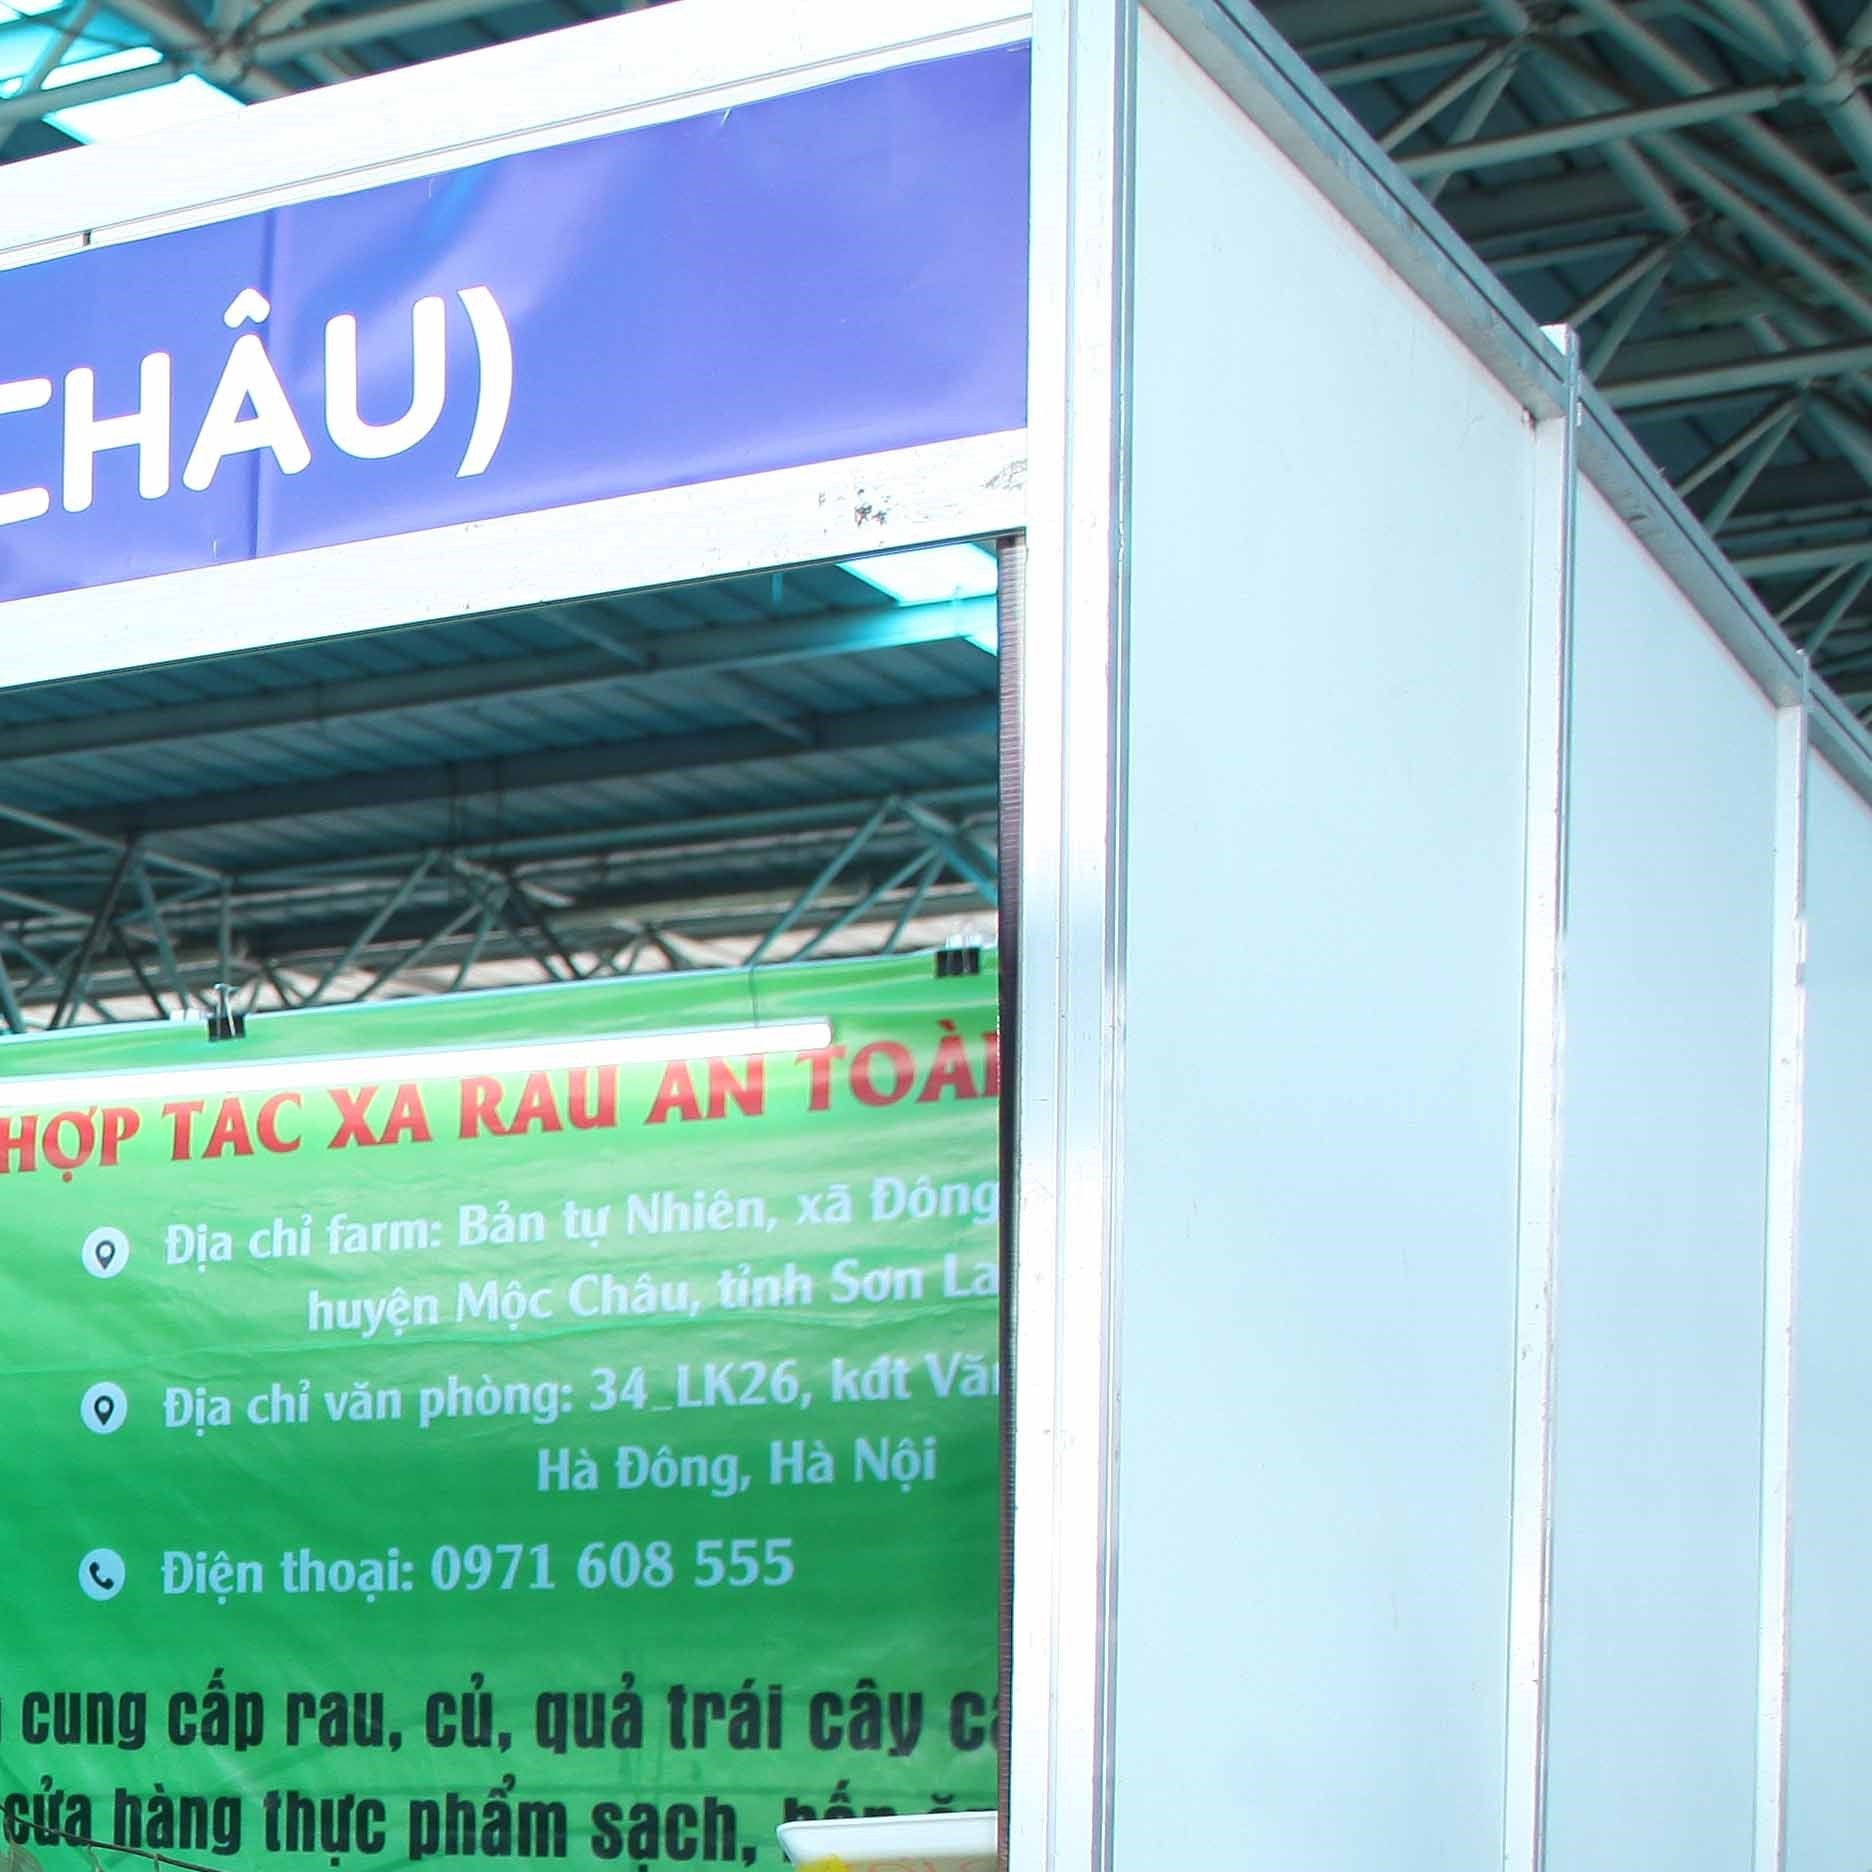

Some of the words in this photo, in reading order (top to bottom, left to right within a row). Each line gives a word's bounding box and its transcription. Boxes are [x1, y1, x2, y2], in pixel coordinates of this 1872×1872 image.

[459, 1065, 617, 1139] RAU
[644, 1054, 765, 1124] AN
[164, 1223, 233, 1272] Địa
[248, 1213, 311, 1258] chỉ
[328, 1214, 441, 1255] farm:
[458, 1200, 545, 1247] Bản
[564, 1200, 610, 1249] tự
[627, 1190, 777, 1238] Nhiên,
[797, 1185, 851, 1225] xã
[308, 1287, 439, 1340] huyện
[456, 1280, 552, 1332] Mộc
[568, 1271, 701, 1320] Châu,
[717, 1263, 812, 1312] tỉnh
[830, 1258, 922, 1306] Sơn
[163, 1385, 232, 1438] Địa
[246, 1379, 311, 1424] chỉ
[328, 1379, 401, 1423] văn
[419, 1374, 572, 1427] phòng:
[830, 1357, 911, 1403] kđt
[925, 1352, 999, 1398] Vă
[537, 1447, 600, 1493] Hà
[615, 1443, 750, 1497] Đông,
[769, 1440, 834, 1486] Hà
[855, 1437, 937, 1492] Nội
[161, 1550, 262, 1605] Điện
[282, 1547, 413, 1603] thoại:
[430, 1543, 555, 1590] 0971
[577, 1540, 675, 1590] 608
[693, 1537, 795, 1588] 555
[22, 1690, 147, 1750] cung
[167, 1667, 263, 1753] cấp
[286, 1688, 402, 1751] rau,
[425, 1671, 513, 1752] củ,
[535, 1670, 645, 1754] quả
[667, 1677, 782, 1750] trái
[809, 1677, 923, 1756] cây
[4, 1775, 92, 1848] cửa
[114, 1782, 241, 1857] hàng
[265, 1789, 386, 1866] thực
[410, 1773, 567, 1861] phẩm
